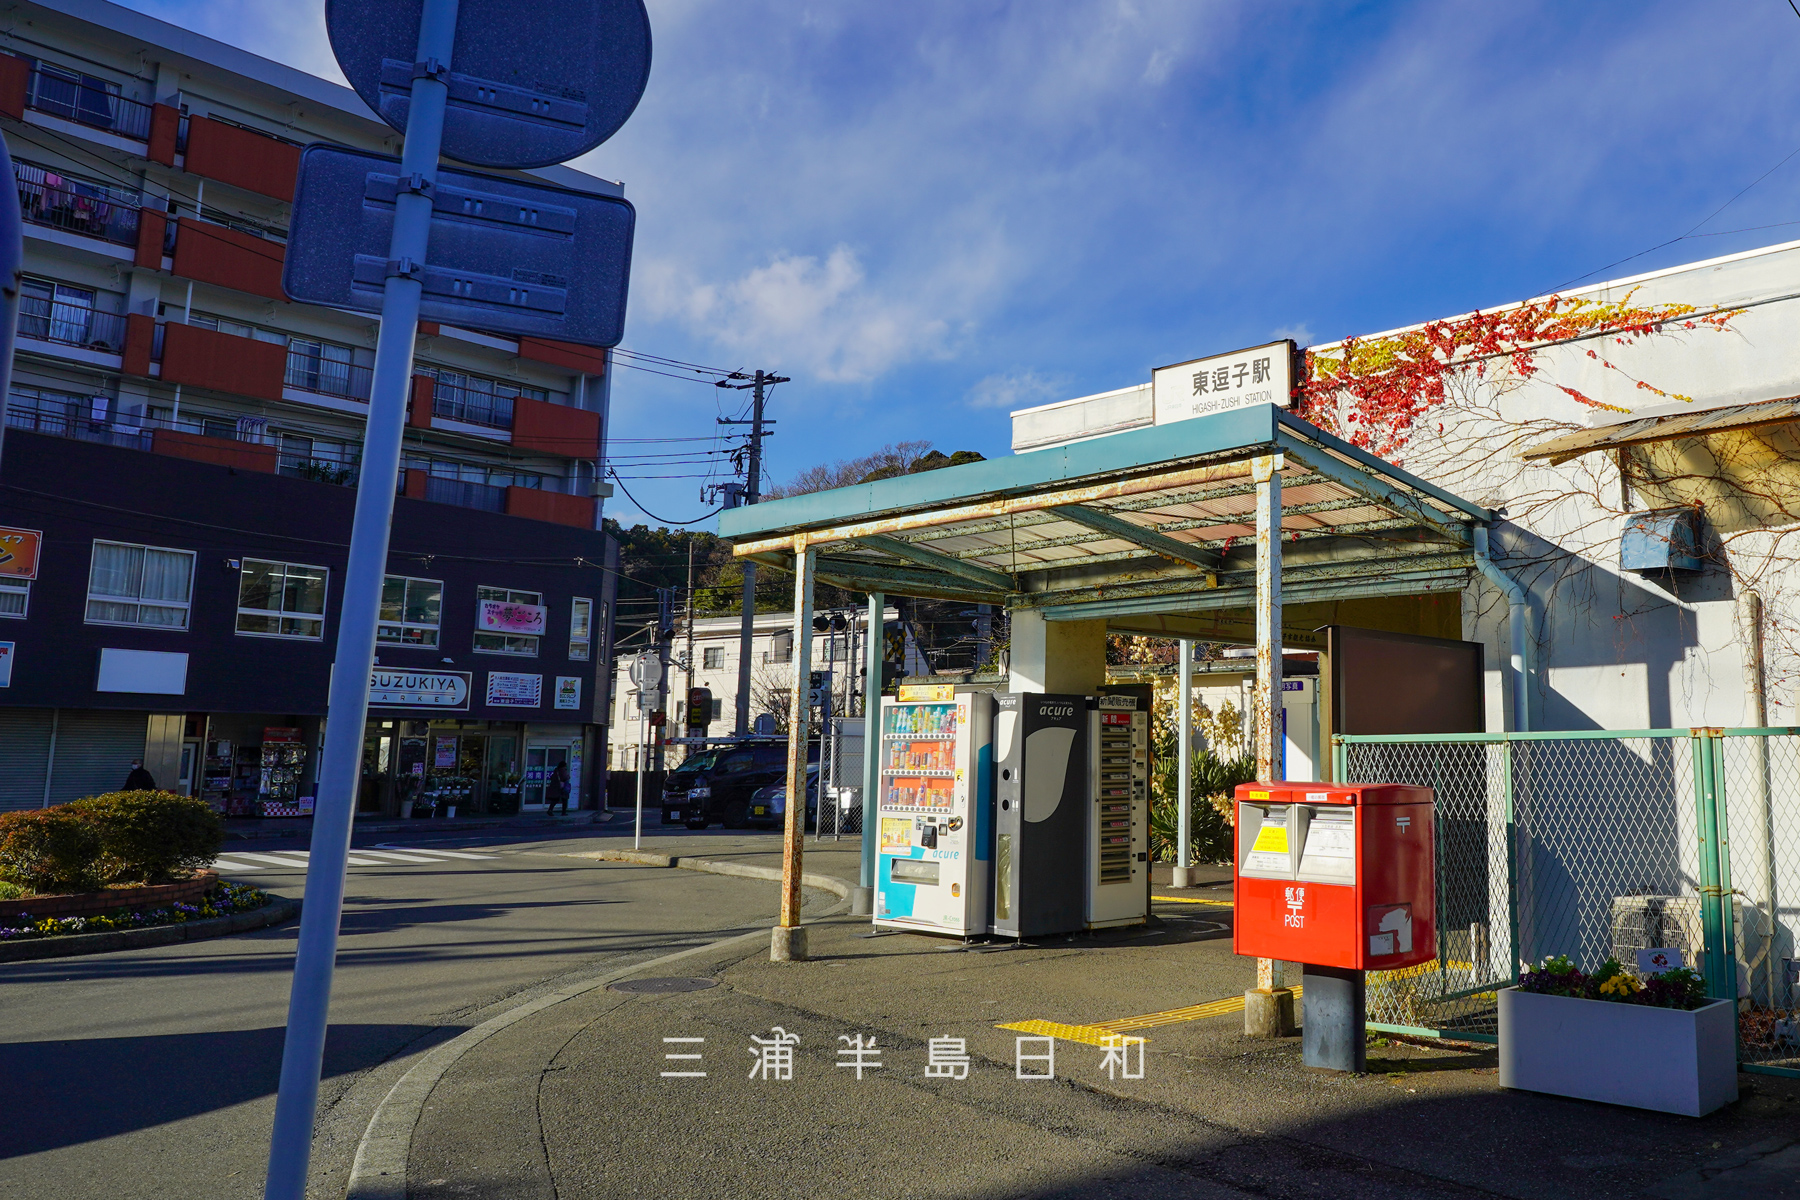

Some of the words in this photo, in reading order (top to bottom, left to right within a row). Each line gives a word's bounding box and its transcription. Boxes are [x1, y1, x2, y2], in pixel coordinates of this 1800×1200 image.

[1192, 357, 1271, 397] 東逗子駅
[1192, 395, 1241, 415] HIGASHI-ZUSHI
[1245, 390, 1272, 405] STATION
[502, 606, 543, 626] 夢ごころ
[1282, 633, 1317, 643] 子市観光協会
[370, 674, 457, 691] SUZUKIYA
[381, 694, 456, 703] ARKET
[1099, 696, 1136, 707] 新聞販売機
[1039, 706, 1074, 717] acure
[1102, 714, 1118, 724] 新聞
[932, 849, 960, 860] acure
[1284, 887, 1305, 903] 郵便
[1284, 914, 1305, 929] POST
